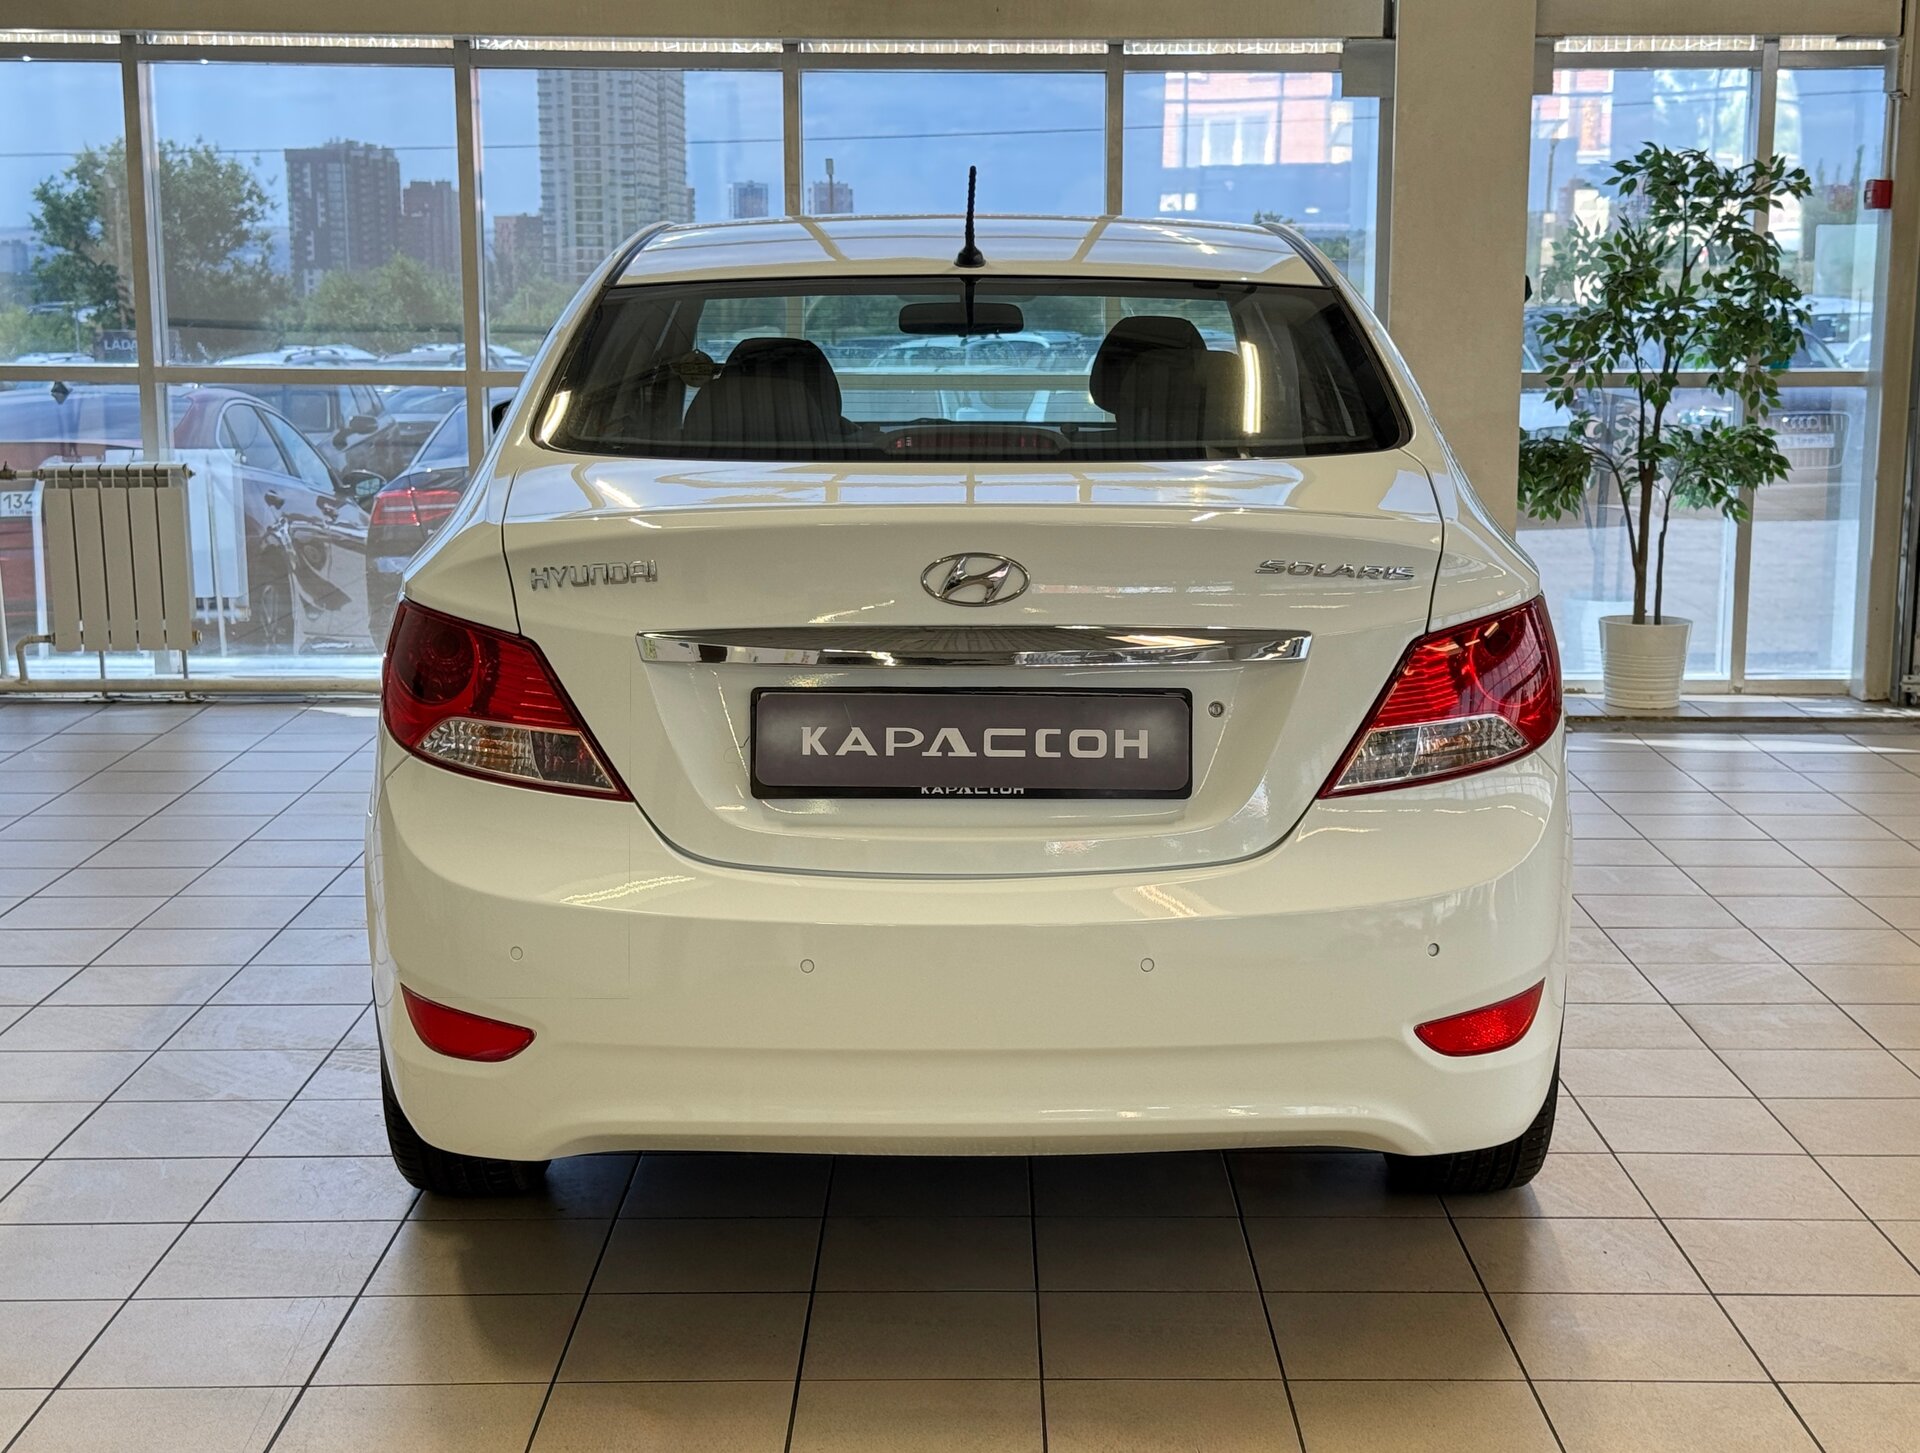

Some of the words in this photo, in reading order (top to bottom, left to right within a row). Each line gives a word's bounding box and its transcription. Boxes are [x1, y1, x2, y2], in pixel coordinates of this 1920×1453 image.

[3, 493, 33, 509] 134
[530, 559, 658, 591] HYUNDAI
[1254, 559, 1415, 580] SOLARIS
